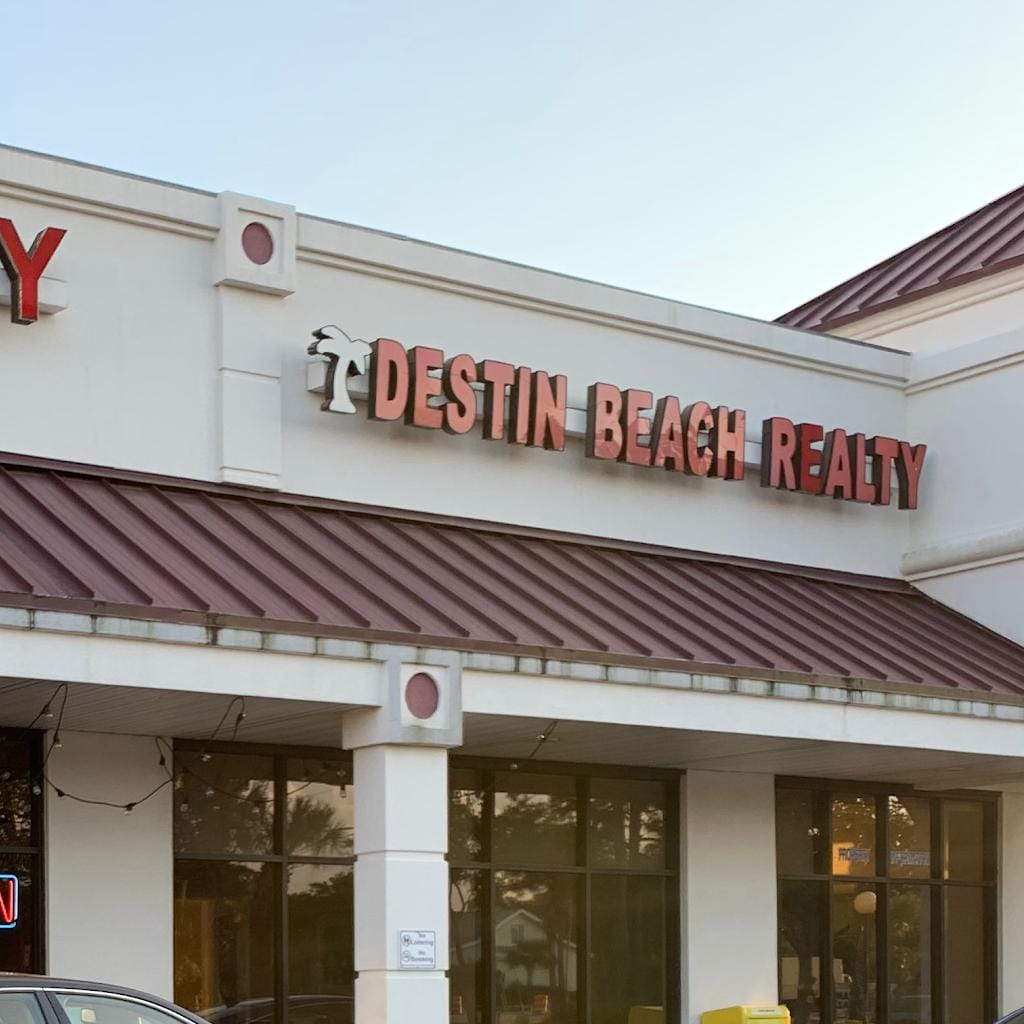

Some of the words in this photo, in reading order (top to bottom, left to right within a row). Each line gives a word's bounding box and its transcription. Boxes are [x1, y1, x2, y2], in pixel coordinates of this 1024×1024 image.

[368, 337, 567, 451] DESTIN
[586, 381, 746, 481] BEACH
[761, 416, 927, 510] REALTY
